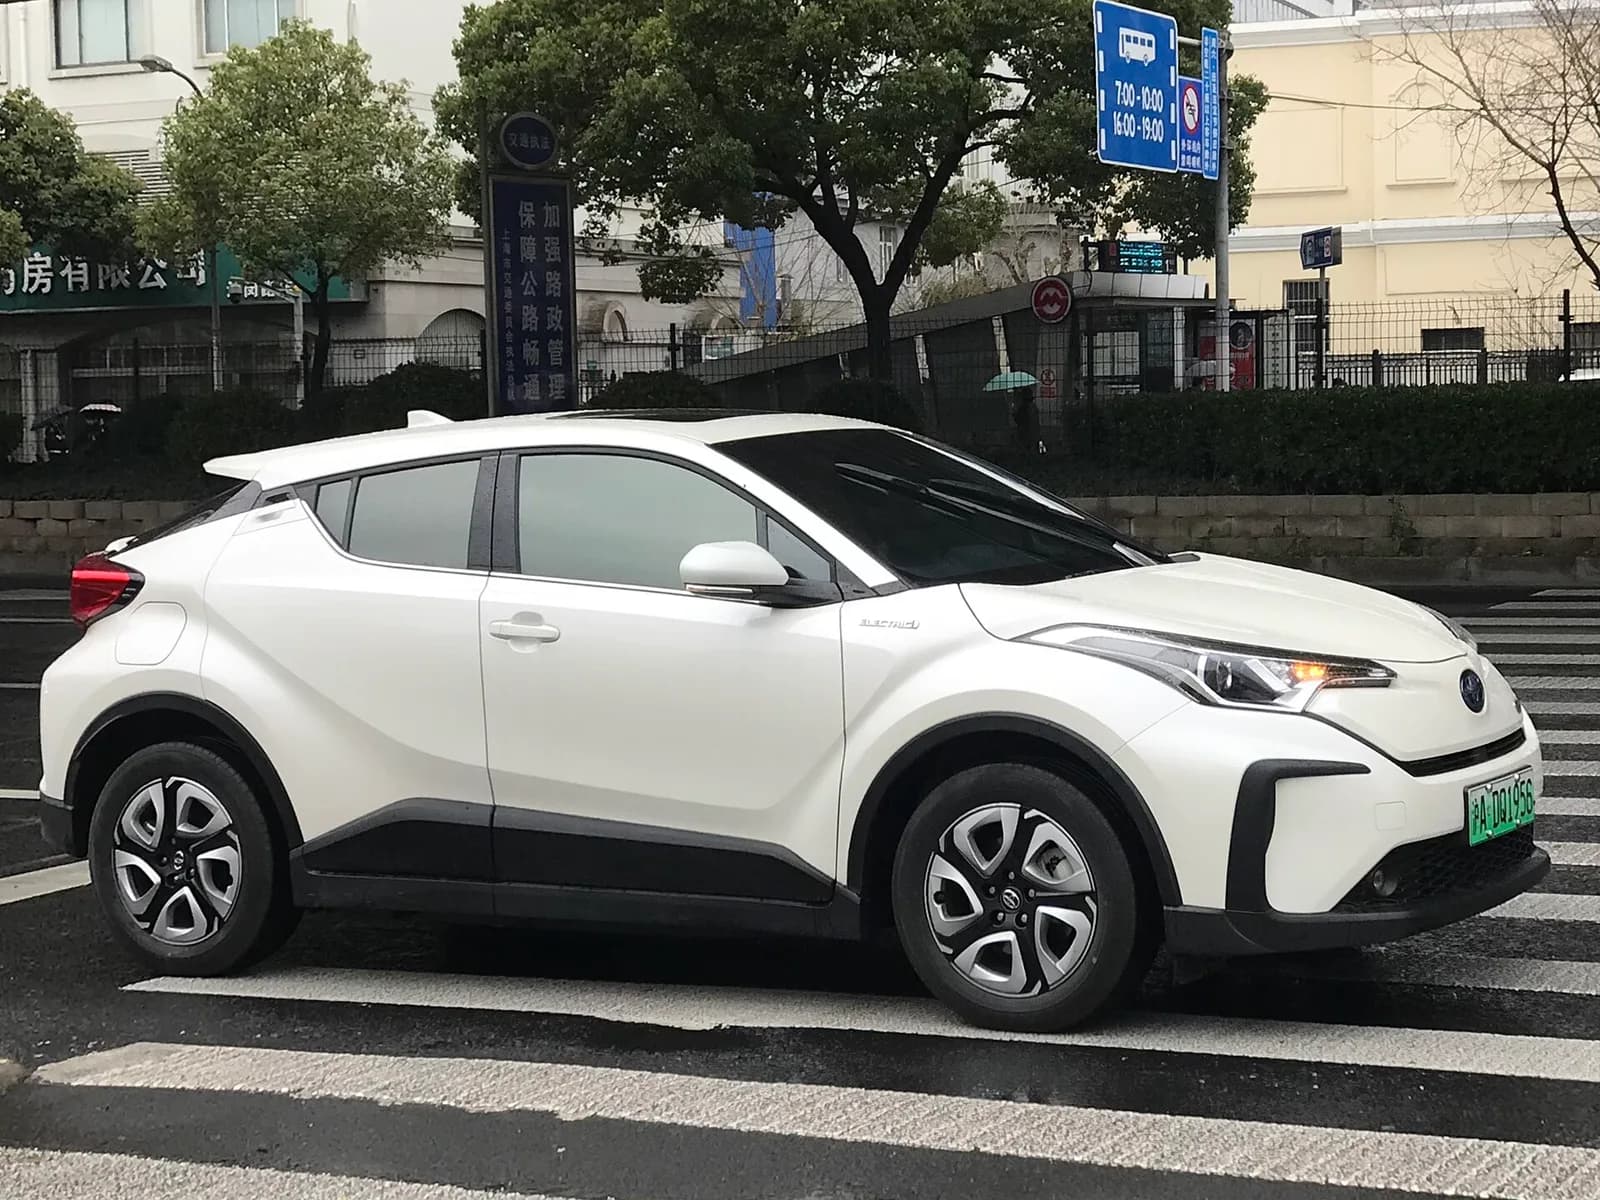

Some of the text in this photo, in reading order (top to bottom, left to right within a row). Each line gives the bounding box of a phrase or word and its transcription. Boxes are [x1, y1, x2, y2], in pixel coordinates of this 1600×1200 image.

[518, 201, 541, 400] 保障公路畅通
[543, 201, 565, 400] 加强路政管理
